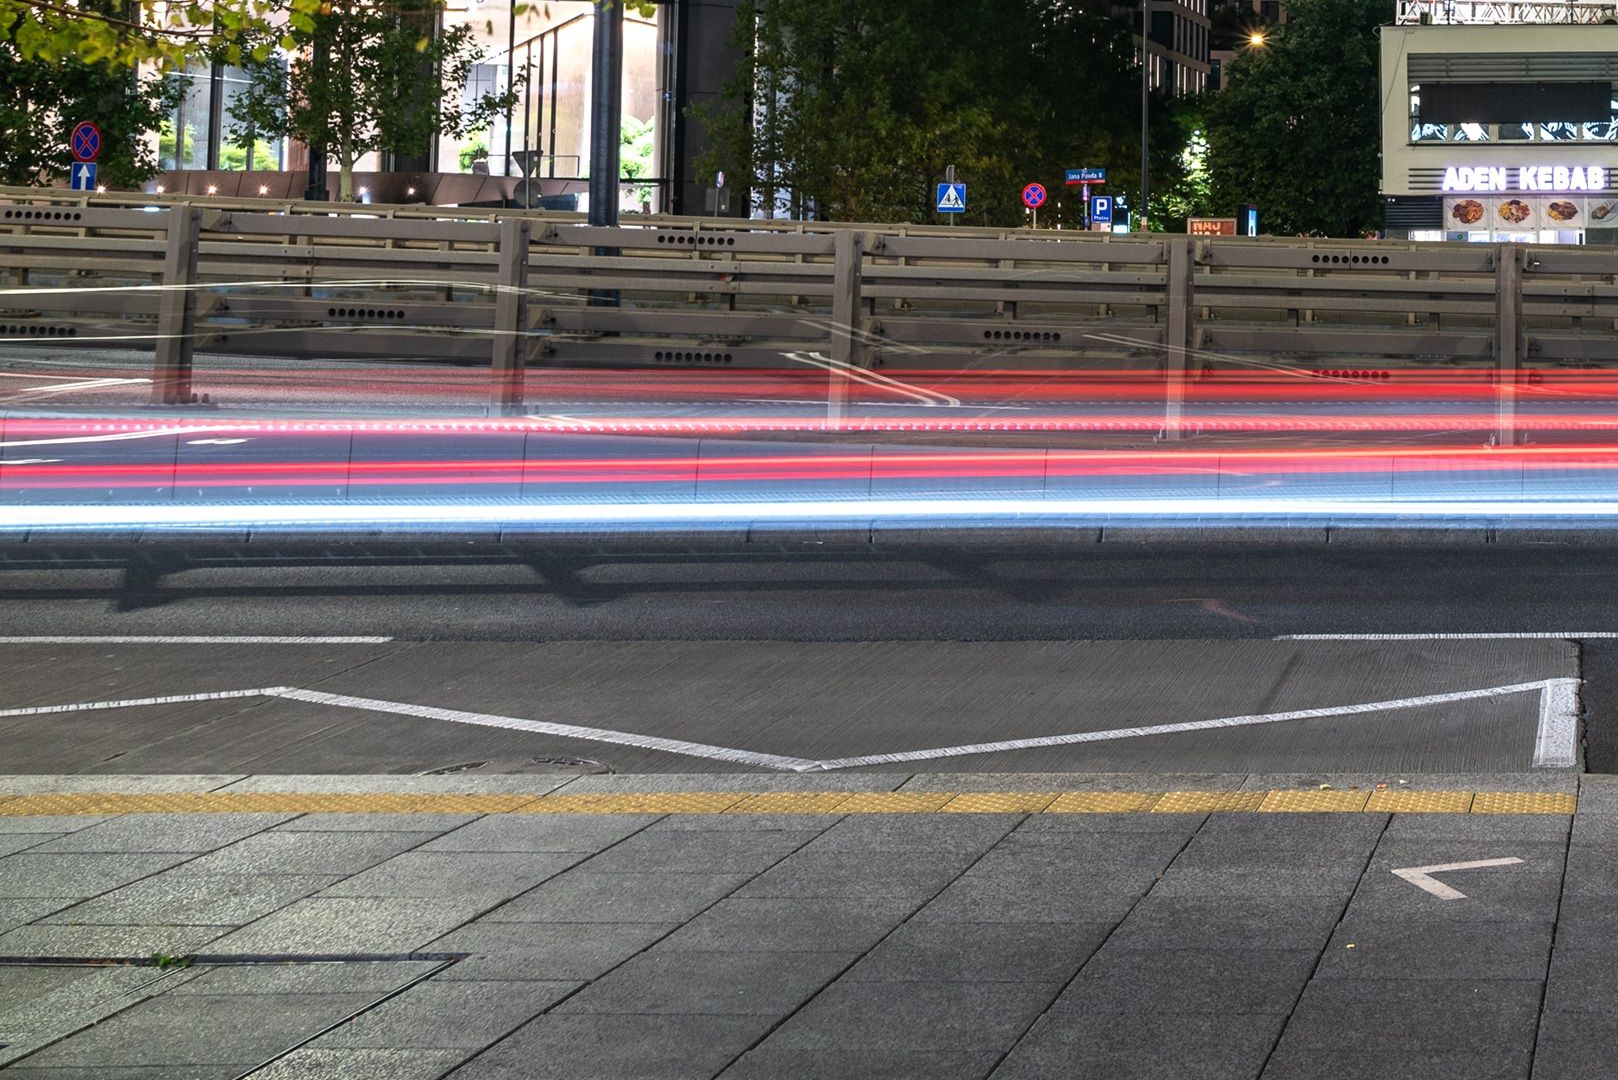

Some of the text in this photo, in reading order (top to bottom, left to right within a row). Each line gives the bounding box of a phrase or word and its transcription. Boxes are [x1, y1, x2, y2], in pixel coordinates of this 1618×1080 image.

[1441, 166, 1605, 191] ADEN KEBAB
[1096, 199, 1108, 215] P
[1193, 222, 1221, 231] NAJ
